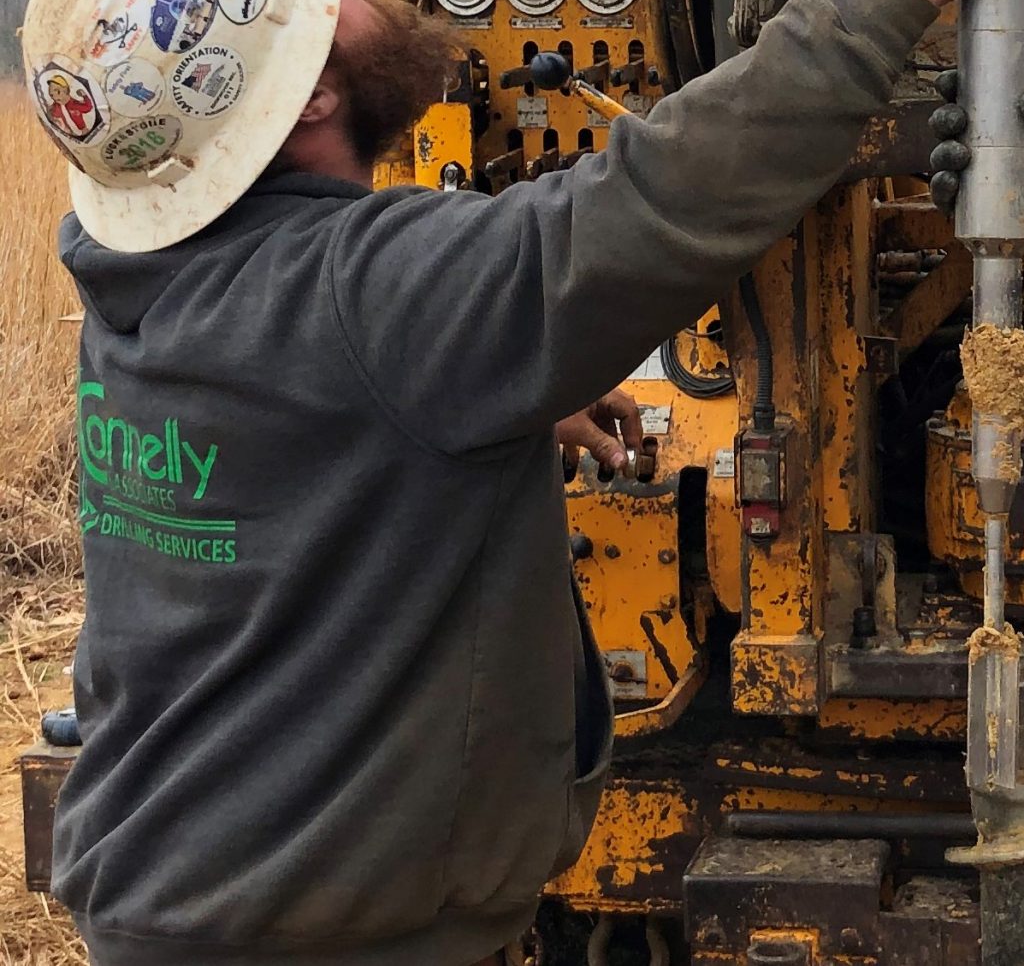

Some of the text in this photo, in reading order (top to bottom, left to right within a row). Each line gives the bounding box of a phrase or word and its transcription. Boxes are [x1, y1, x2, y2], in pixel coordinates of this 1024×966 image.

[173, 47, 228, 82] ORIENTATION
[172, 85, 193, 113] SAFETY
[78, 381, 218, 500] Connelly
[100, 512, 236, 563] DRILLING SERVICES
